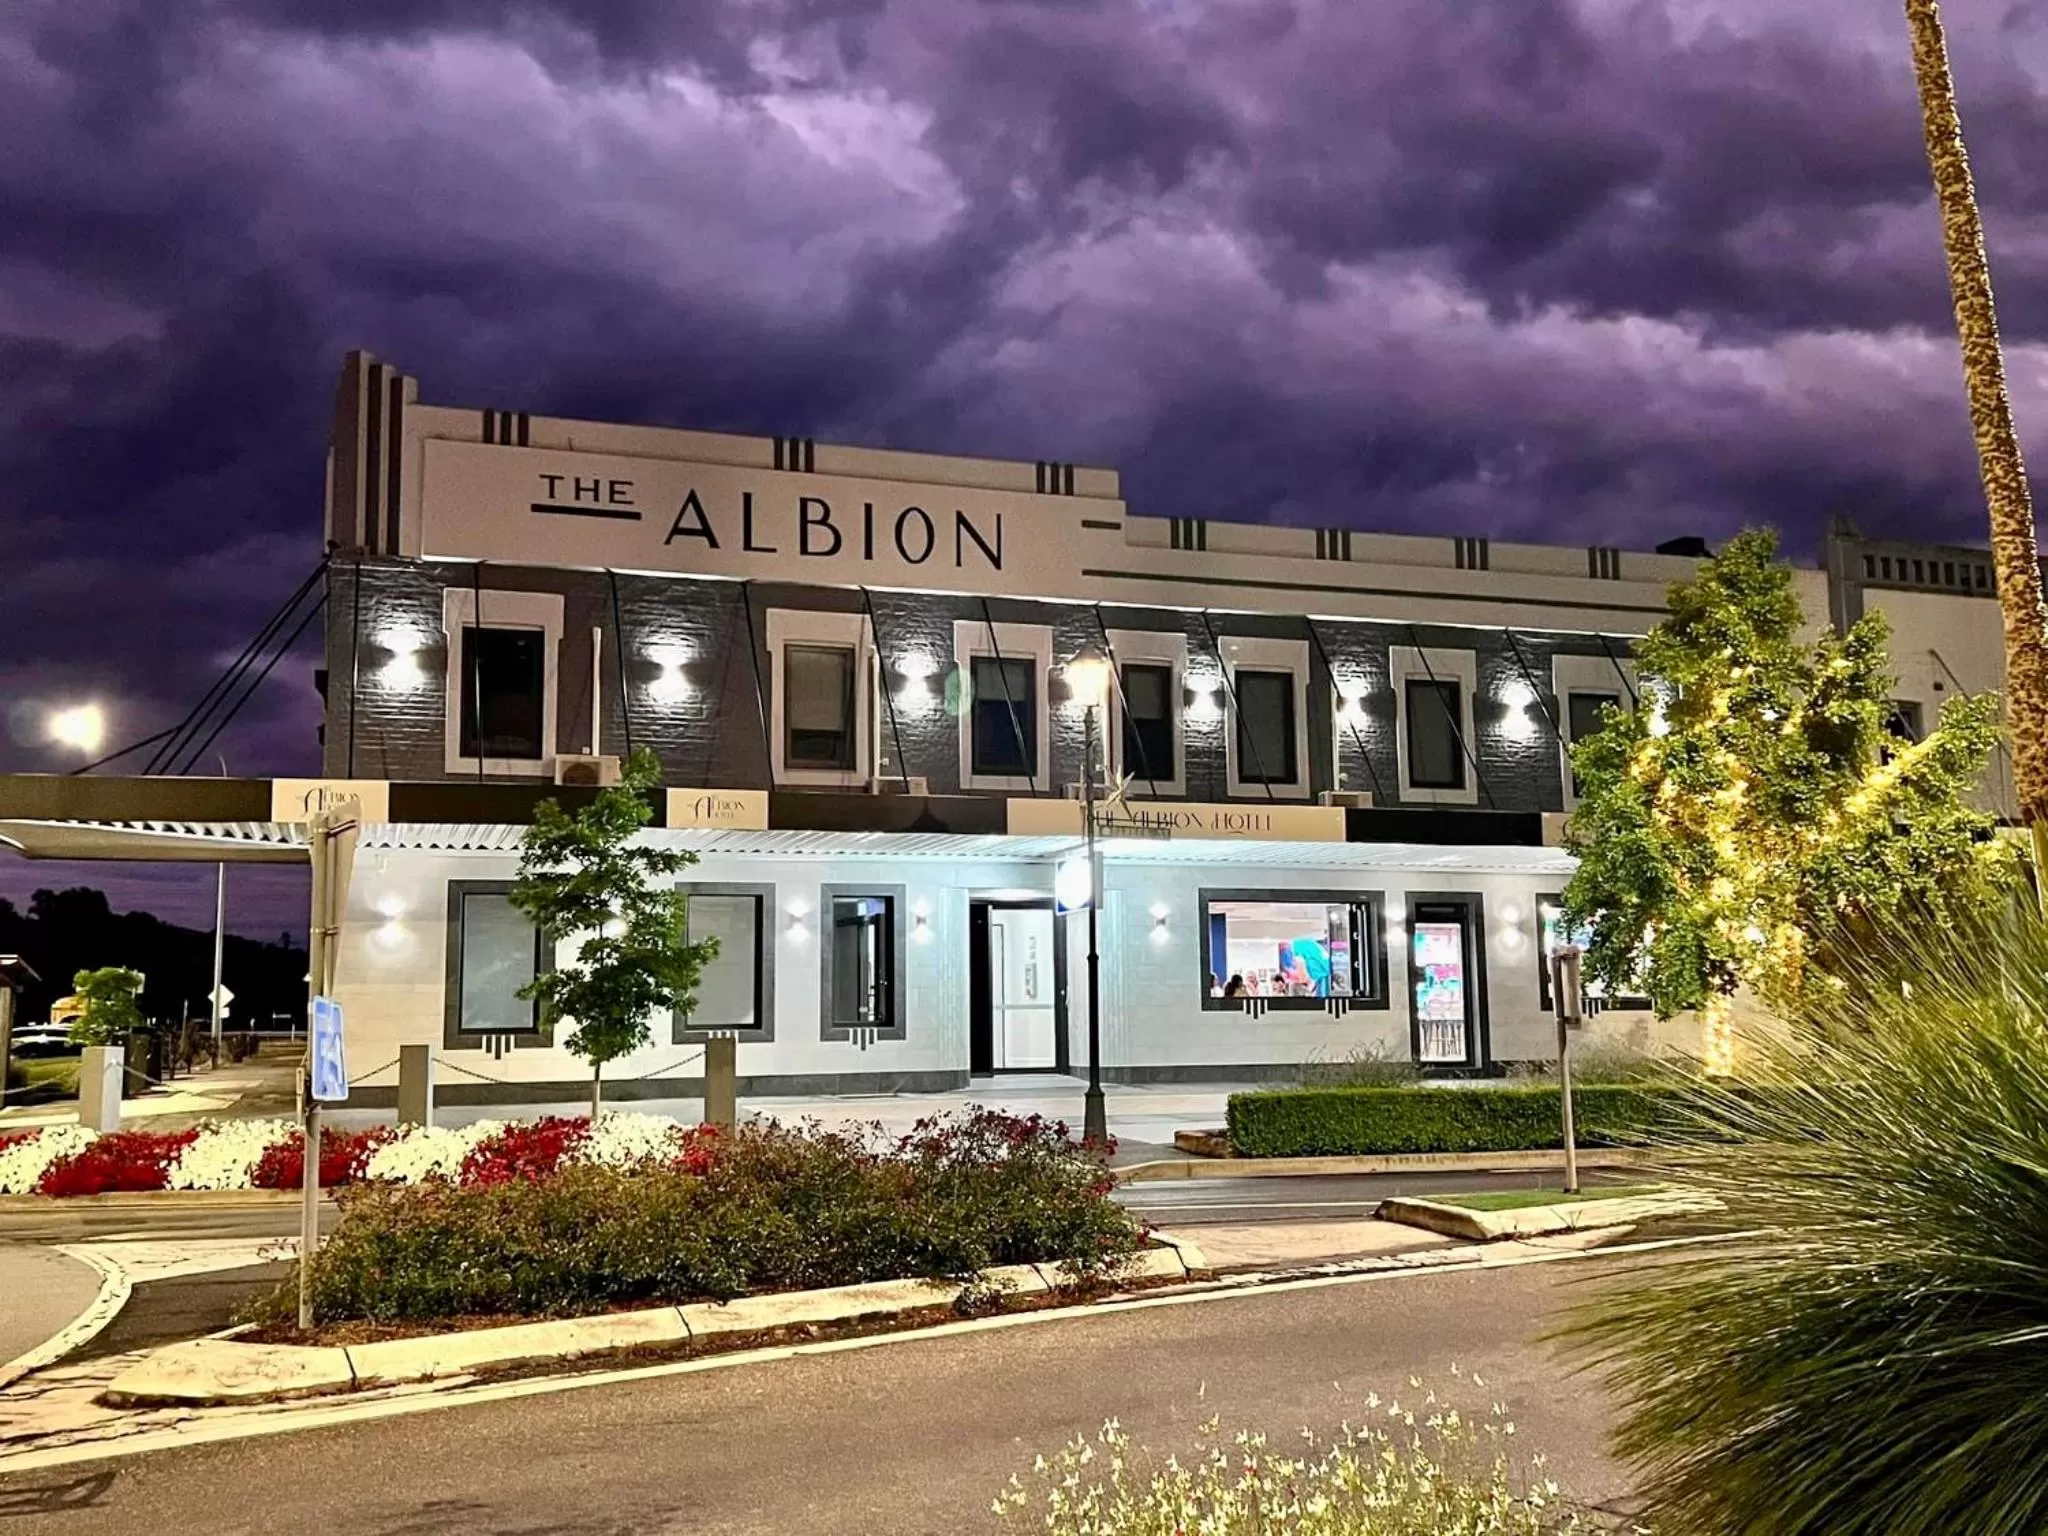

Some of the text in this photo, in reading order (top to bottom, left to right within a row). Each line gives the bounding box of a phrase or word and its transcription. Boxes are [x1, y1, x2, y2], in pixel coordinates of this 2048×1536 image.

[538, 473, 1003, 571] THE ALBION
[1211, 811, 1272, 834] HOTEL
